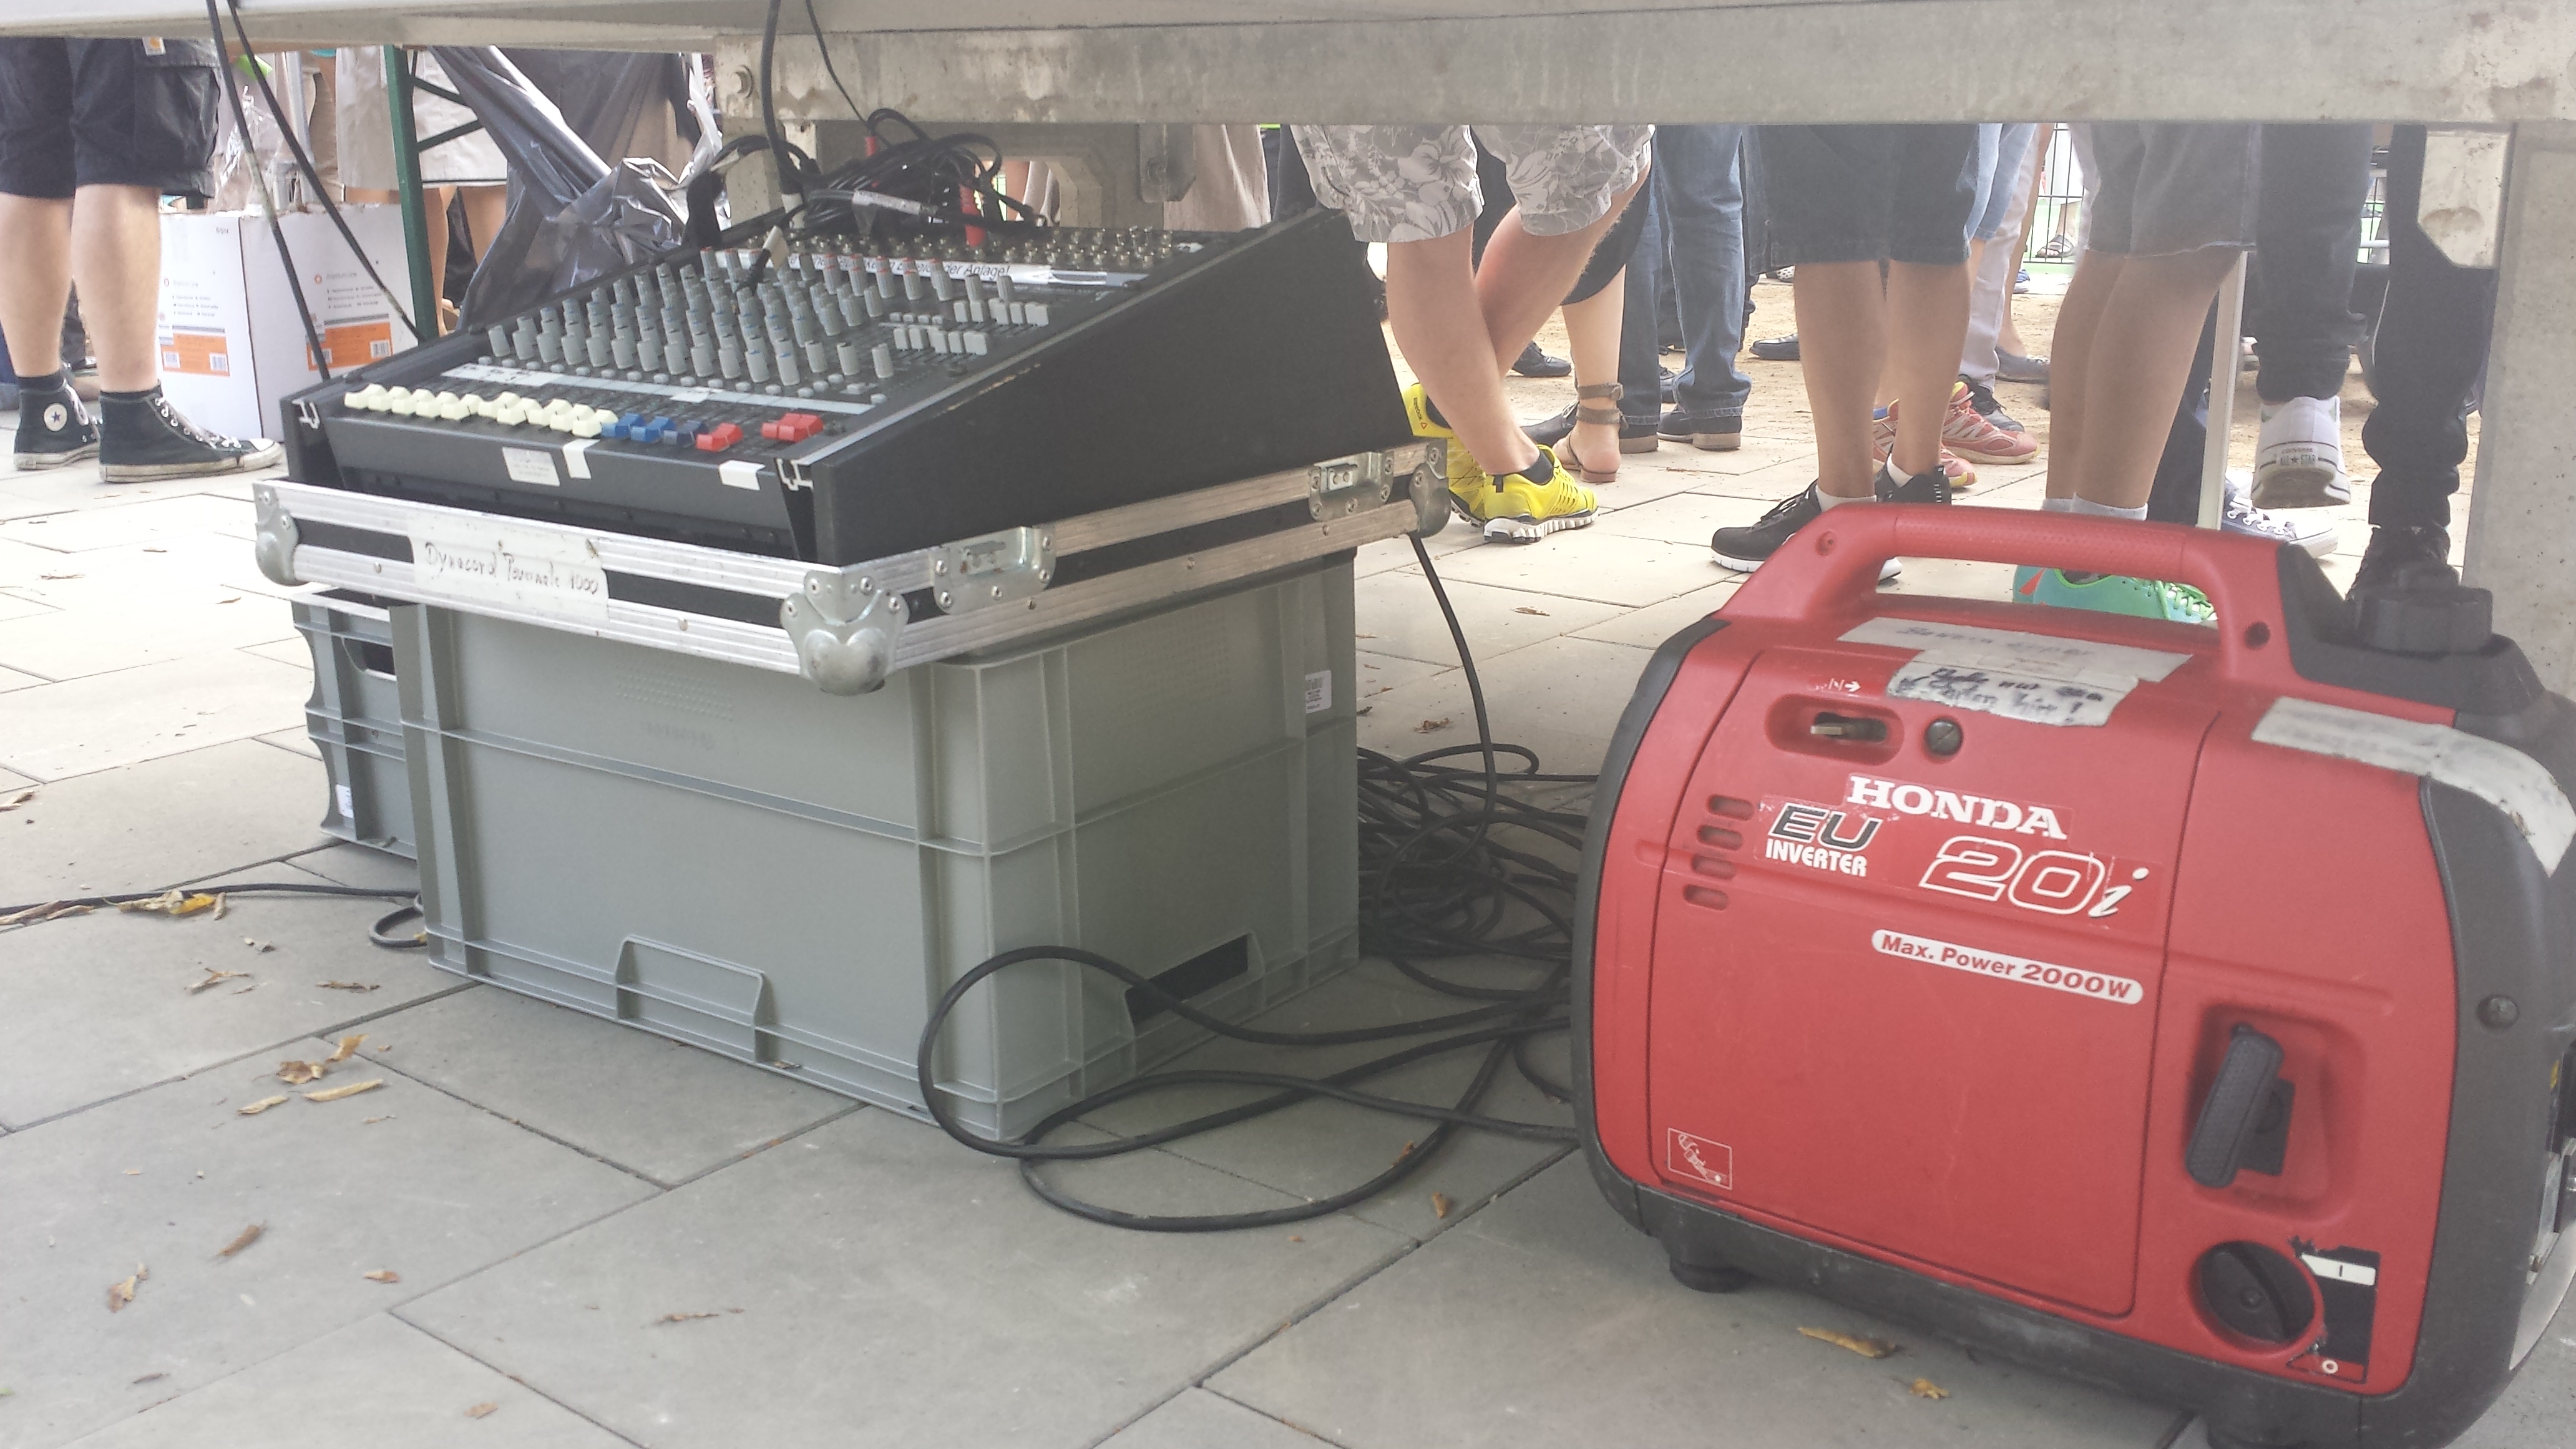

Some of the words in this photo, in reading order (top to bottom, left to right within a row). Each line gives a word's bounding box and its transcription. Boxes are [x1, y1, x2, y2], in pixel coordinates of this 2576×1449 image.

[1413, 398, 1422, 421] Reebok
[1768, 803, 1883, 852] EU
[1848, 776, 2067, 840] HONDA
[1765, 838, 1867, 877] INVERTER
[1919, 836, 2150, 917] 20i
[1881, 935, 1934, 960] Max.
[1940, 947, 2016, 975] Power
[2021, 964, 2132, 998] 2000W
